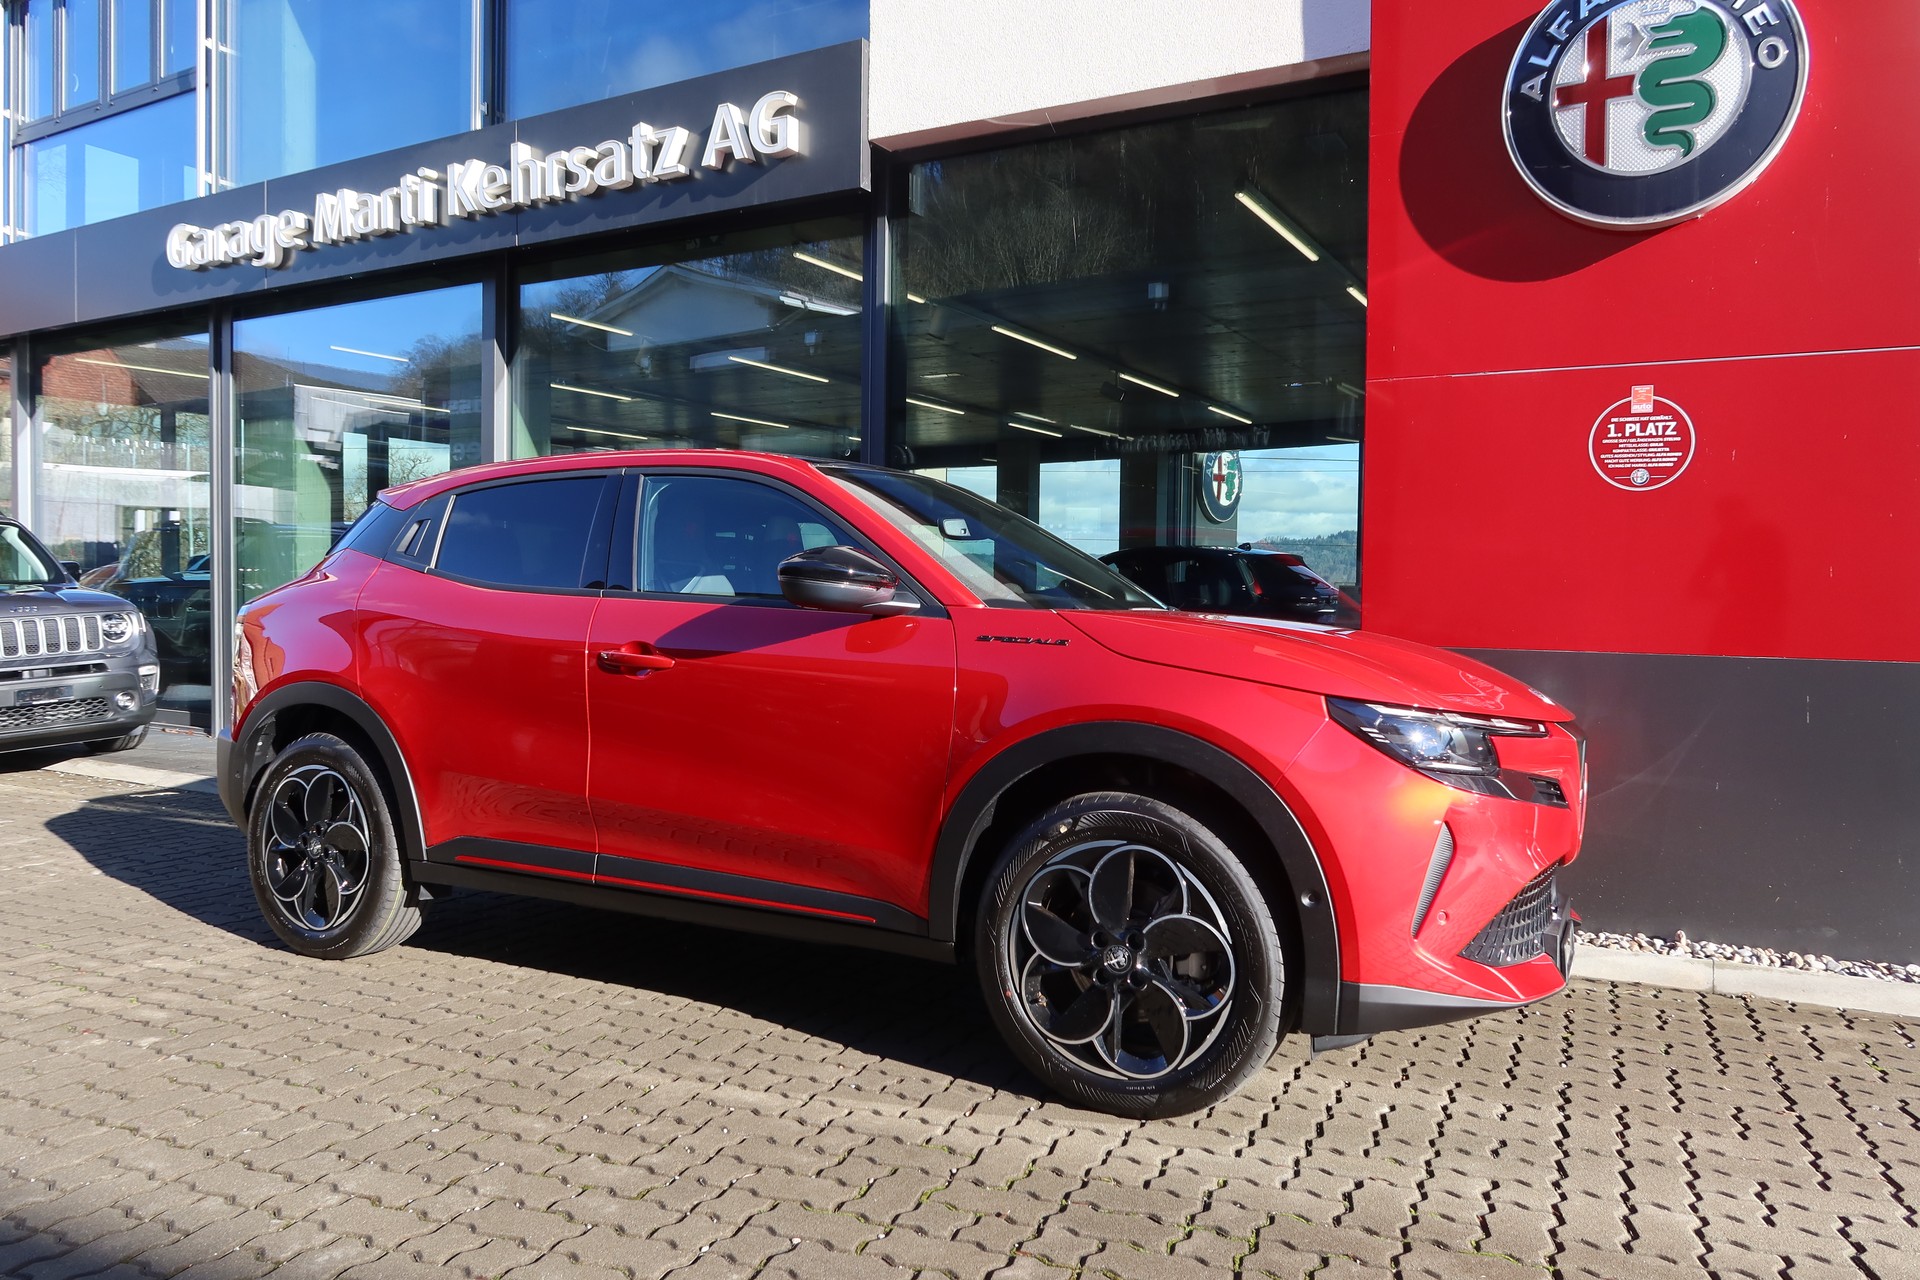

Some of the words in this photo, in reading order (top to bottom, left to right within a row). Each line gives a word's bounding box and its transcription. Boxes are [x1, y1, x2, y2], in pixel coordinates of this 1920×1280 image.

[166, 209, 309, 270] Garage
[312, 166, 439, 244] Marti
[446, 121, 691, 218] Kehrsatz
[701, 90, 801, 171] AG
[1607, 423, 1622, 437] 1.
[1625, 421, 1677, 437] PLATZ
